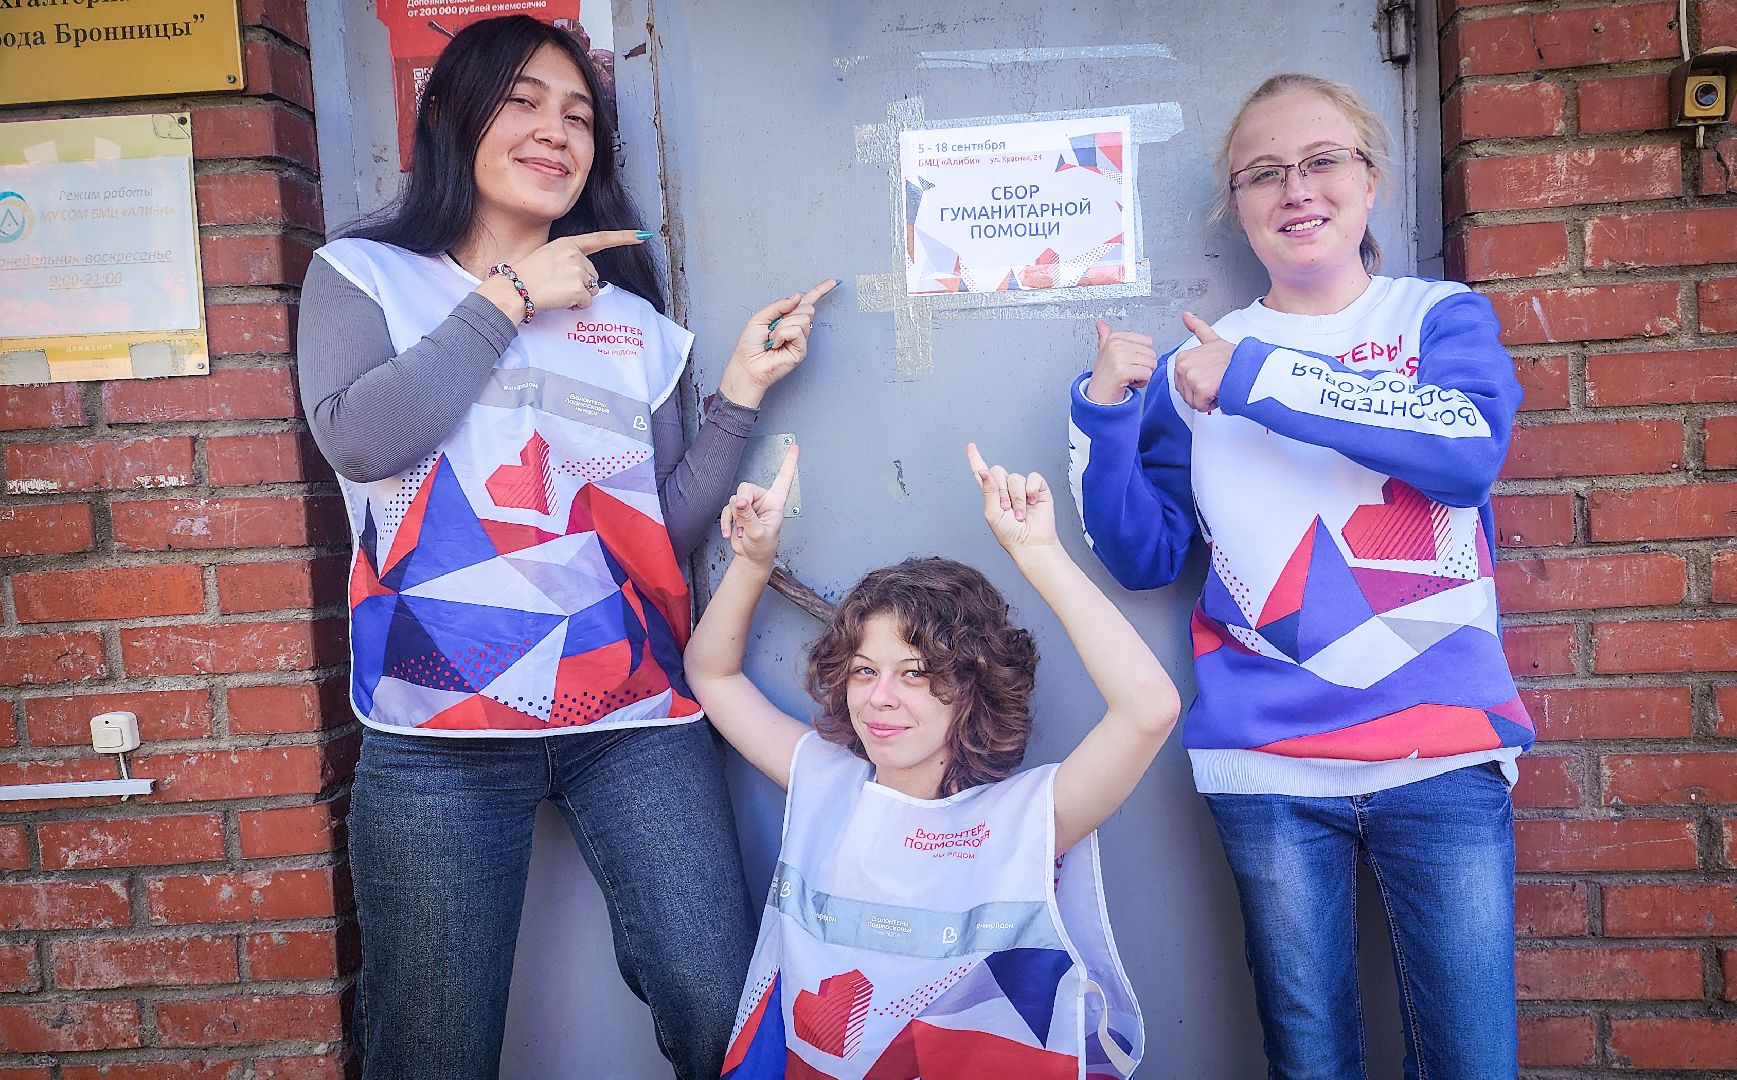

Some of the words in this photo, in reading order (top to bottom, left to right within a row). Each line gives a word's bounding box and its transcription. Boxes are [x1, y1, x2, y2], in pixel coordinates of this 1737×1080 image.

[420, 7, 438, 16] 200
[439, 6, 457, 15] 000
[459, 4, 490, 15] рублей
[492, 0, 547, 11] ежемесячно
[0, 31, 46, 50] ода
[918, 144, 924, 153] 5
[935, 142, 948, 153] 18
[951, 139, 1006, 152] сентября
[918, 158, 940, 168] БМЦ
[60, 190, 100, 201] Режим
[103, 187, 153, 202] работы
[991, 184, 1040, 201] СБОР
[940, 197, 1091, 222] ГУМАНИТАРНОЙ
[970, 222, 1060, 240] ПОМОЩИ
[0, 249, 173, 269] онедельник-воскресенье
[567, 332, 644, 349] ПОДМОСКОВ
[1335, 334, 1402, 364] ТЕРЫ
